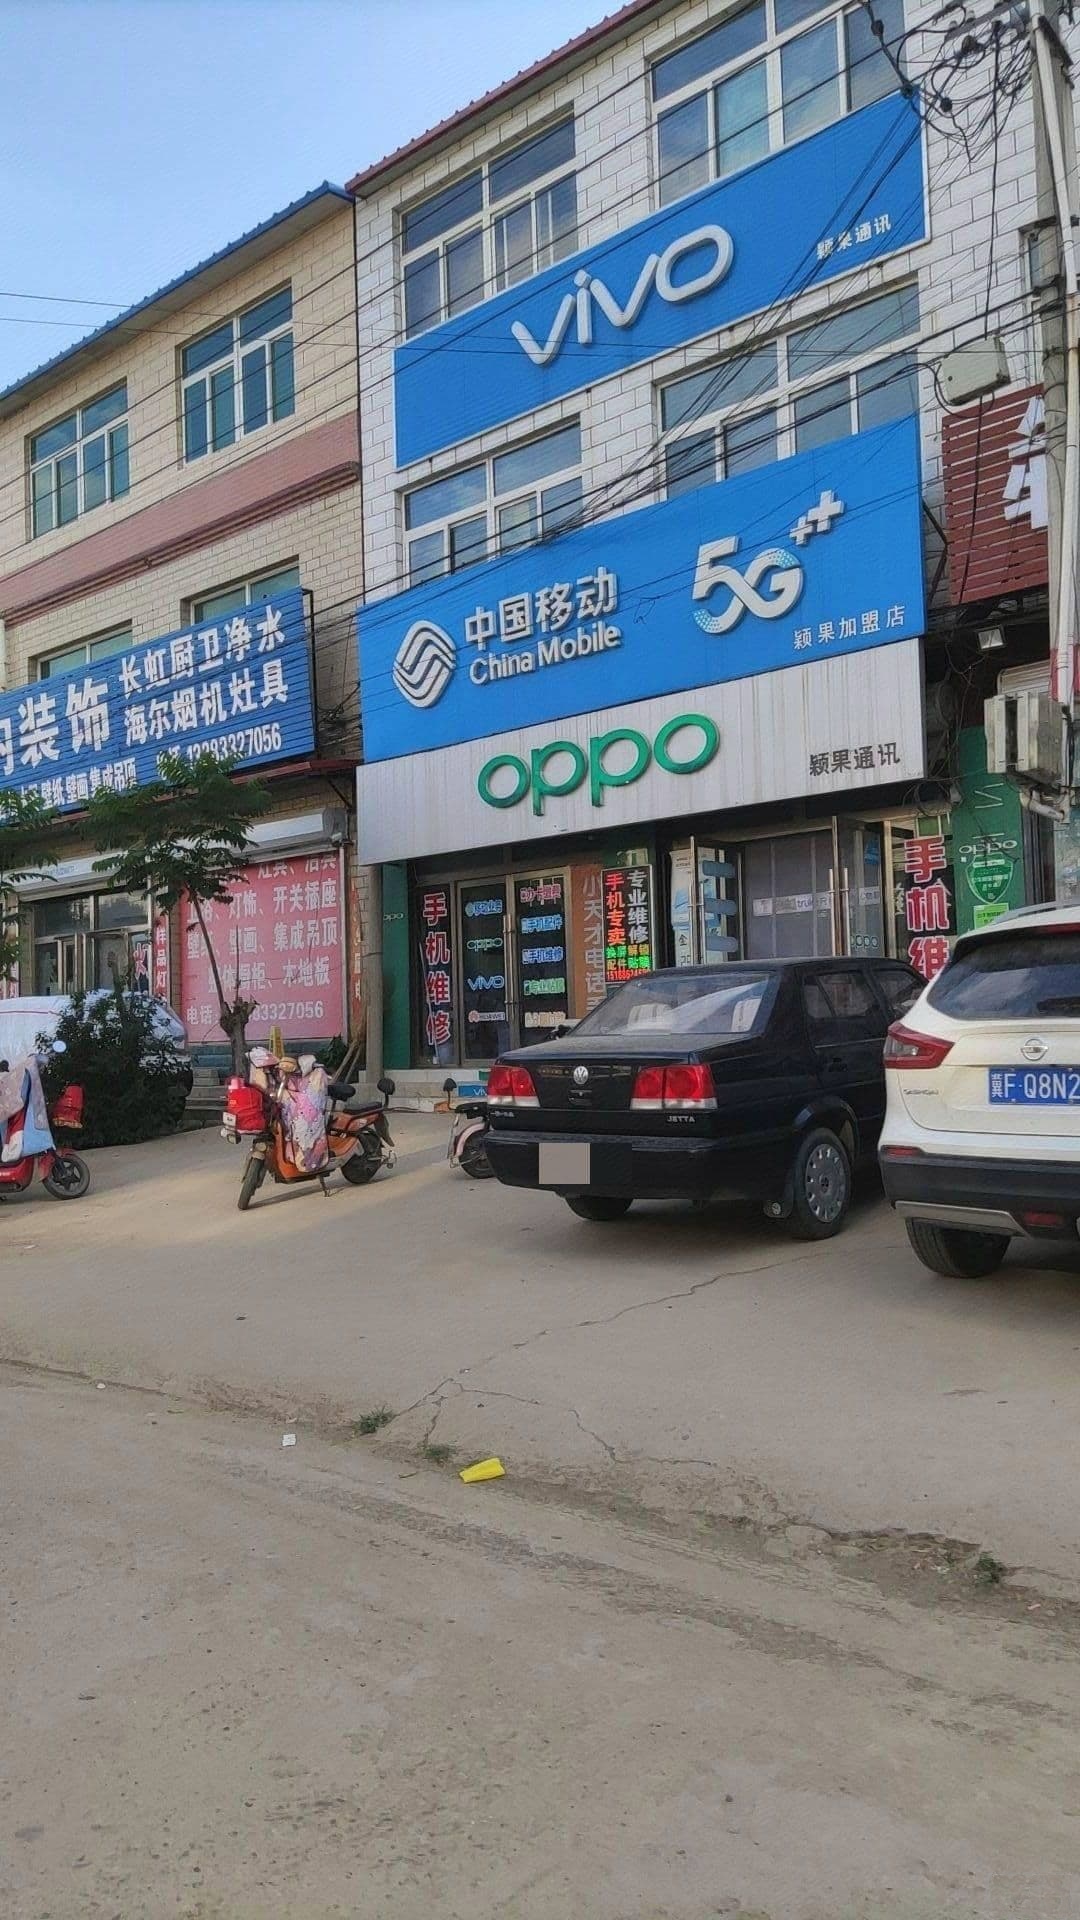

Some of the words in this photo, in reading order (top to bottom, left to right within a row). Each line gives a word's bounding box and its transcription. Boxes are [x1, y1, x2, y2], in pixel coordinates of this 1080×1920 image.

[510, 223, 734, 366] vivo
[464, 566, 620, 652] 中国移动
[792, 604, 908, 651] 颖果加盟店
[118, 605, 286, 699] 长虹厨卫净水
[469, 650, 535, 687] China
[537, 624, 622, 668] Mobile
[124, 658, 289, 747] 海尔烟机灶具
[477, 713, 720, 816] oppo
[809, 740, 902, 778] 颖果通讯
[467, 938, 503, 952] oppo
[605, 872, 626, 946] 手机专卖
[627, 870, 649, 944] 专业维修
[904, 835, 950, 980] 手机维
[423, 892, 451, 1045] 手机维修
[667, 1115, 695, 1123] JETTA
